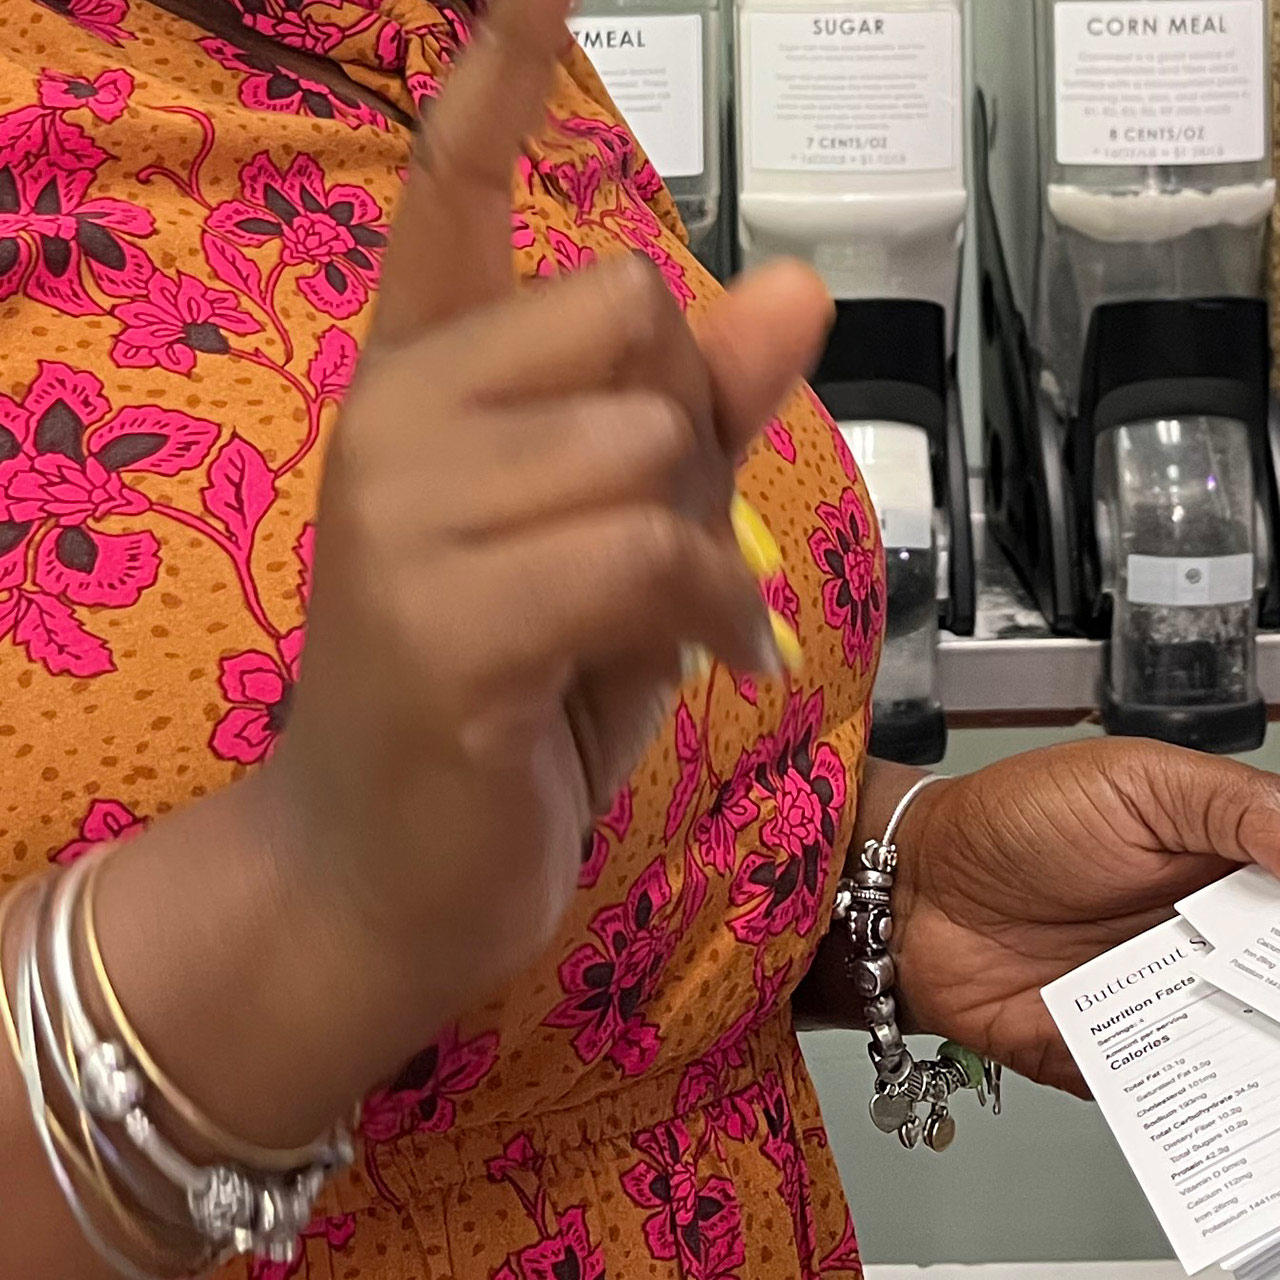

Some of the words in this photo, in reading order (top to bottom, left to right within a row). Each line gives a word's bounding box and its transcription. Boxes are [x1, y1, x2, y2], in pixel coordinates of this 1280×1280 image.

[813, 18, 884, 35] SUGAR
[1087, 17, 1157, 36] CORN
[1168, 16, 1226, 35] MEAL
[573, 28, 646, 49] TMEAL
[1124, 126, 1205, 142] CENTS/OZ
[1074, 948, 1184, 1012] Butternut
[1090, 999, 1153, 1036] Nutrition
[1155, 977, 1195, 1000] Facts
[1110, 1035, 1170, 1070] Calories
[1146, 1071, 1160, 1081] Fat
